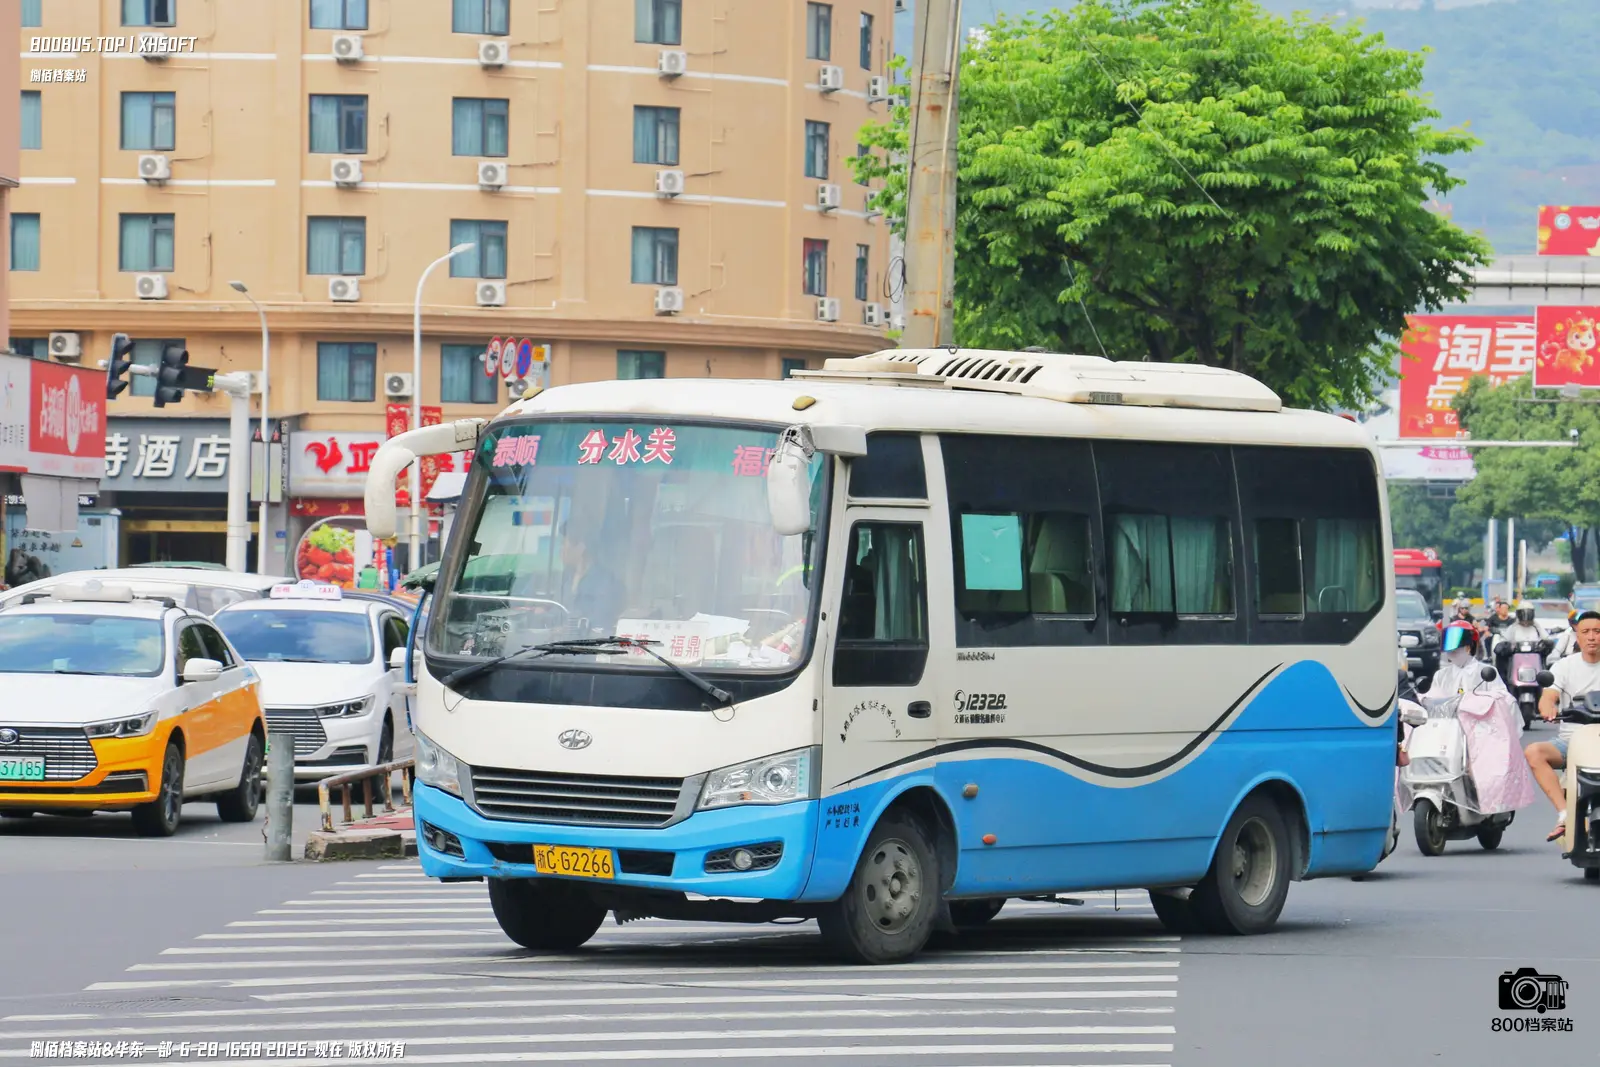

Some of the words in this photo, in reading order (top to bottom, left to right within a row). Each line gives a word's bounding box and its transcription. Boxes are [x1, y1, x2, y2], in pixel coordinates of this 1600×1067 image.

[1433, 322, 1535, 373] 淘宝
[492, 434, 541, 467] 泰顺
[577, 427, 677, 465] 分水关
[670, 635, 701, 658] 福鼎
